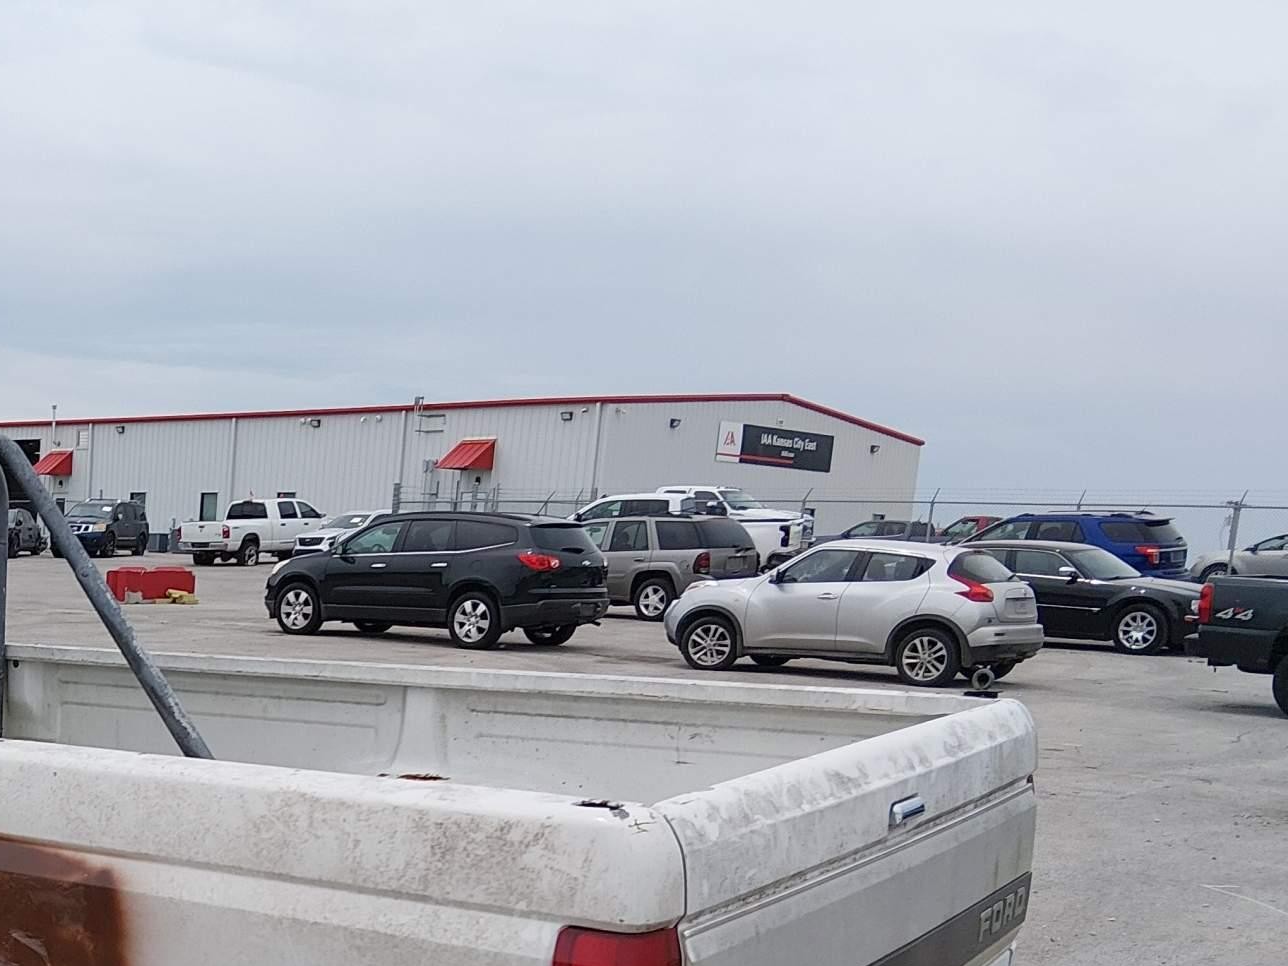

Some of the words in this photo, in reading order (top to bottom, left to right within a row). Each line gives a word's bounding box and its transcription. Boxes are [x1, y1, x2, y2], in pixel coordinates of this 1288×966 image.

[773, 435, 793, 448] Kansas
[793, 437, 805, 452] City
[804, 439, 817, 451] East
[978, 886, 1026, 943] FORD
